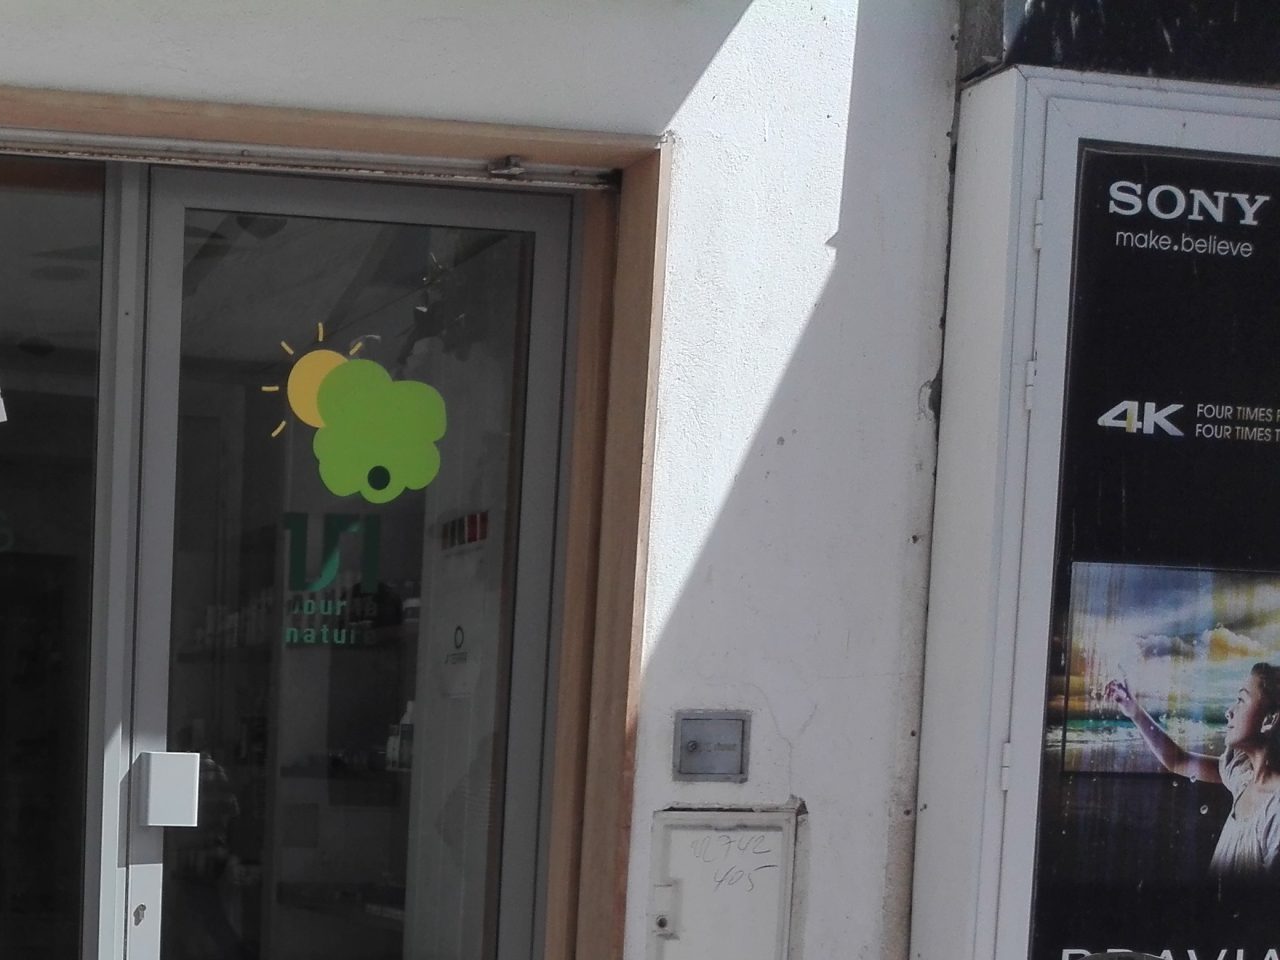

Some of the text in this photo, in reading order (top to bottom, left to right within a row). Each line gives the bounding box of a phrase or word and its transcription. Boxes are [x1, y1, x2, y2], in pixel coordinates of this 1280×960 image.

[1109, 181, 1269, 225] SONY
[1115, 230, 1253, 258] make.believe
[1097, 400, 1184, 436] 4K
[1197, 403, 1233, 419] FOUR
[1236, 406, 1273, 422] TIMES
[1195, 423, 1232, 439] FOUR
[1235, 426, 1272, 442] TIMES
